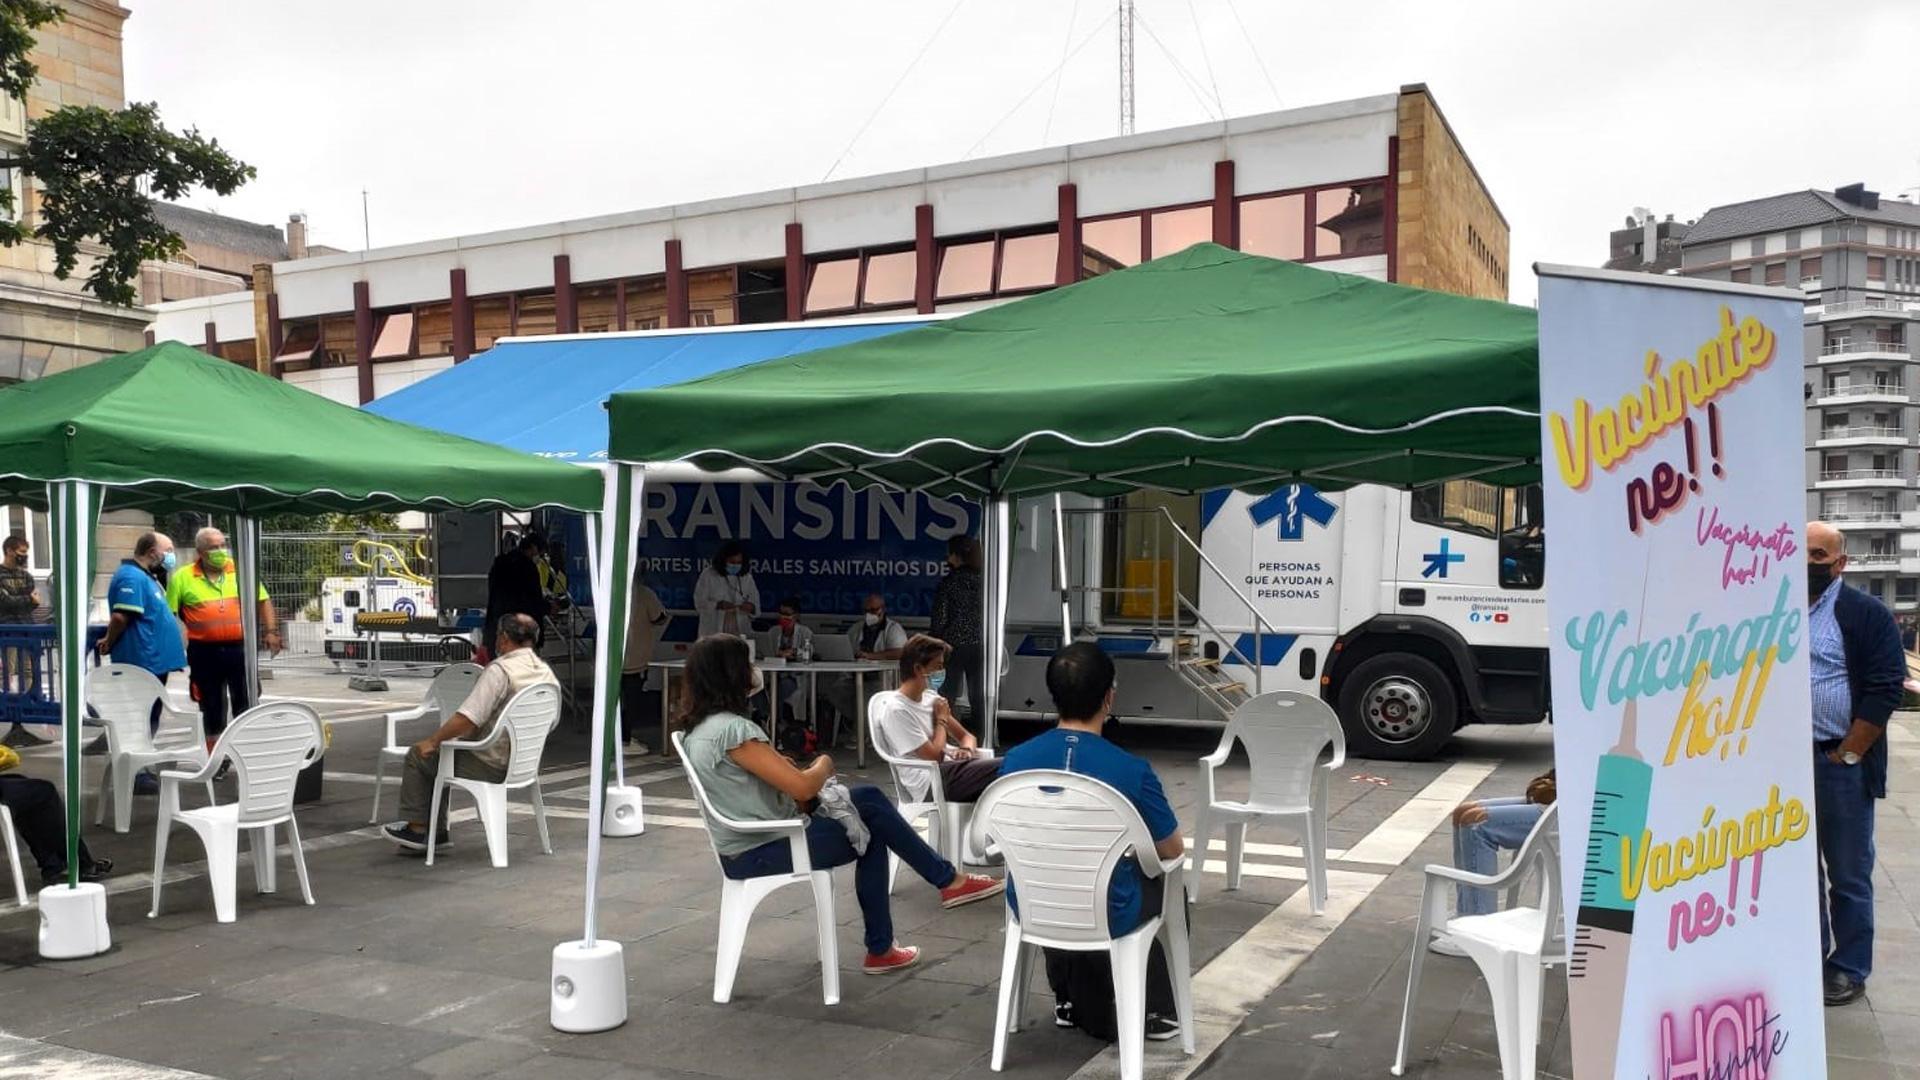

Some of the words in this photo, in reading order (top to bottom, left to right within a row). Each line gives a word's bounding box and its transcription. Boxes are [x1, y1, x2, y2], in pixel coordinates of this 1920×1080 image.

[1549, 304, 1776, 491] Vacúnate
[1626, 402, 1723, 533] ne!!
[639, 482, 970, 541] RANSINS
[697, 558, 804, 575] INRALES
[808, 560, 920, 576] SANITARIOS
[925, 562, 953, 577] DE
[1245, 575, 1269, 585] QUE
[1272, 576, 1322, 585] AYUDAN
[1326, 576, 1334, 585] A
[1258, 589, 1320, 599] PERSONAS
[1259, 562, 1321, 572] PERSONAS
[1662, 644, 1778, 767] ho!!
[1620, 785, 1809, 901] Vacúnate
[1668, 848, 1763, 951] ne!!
